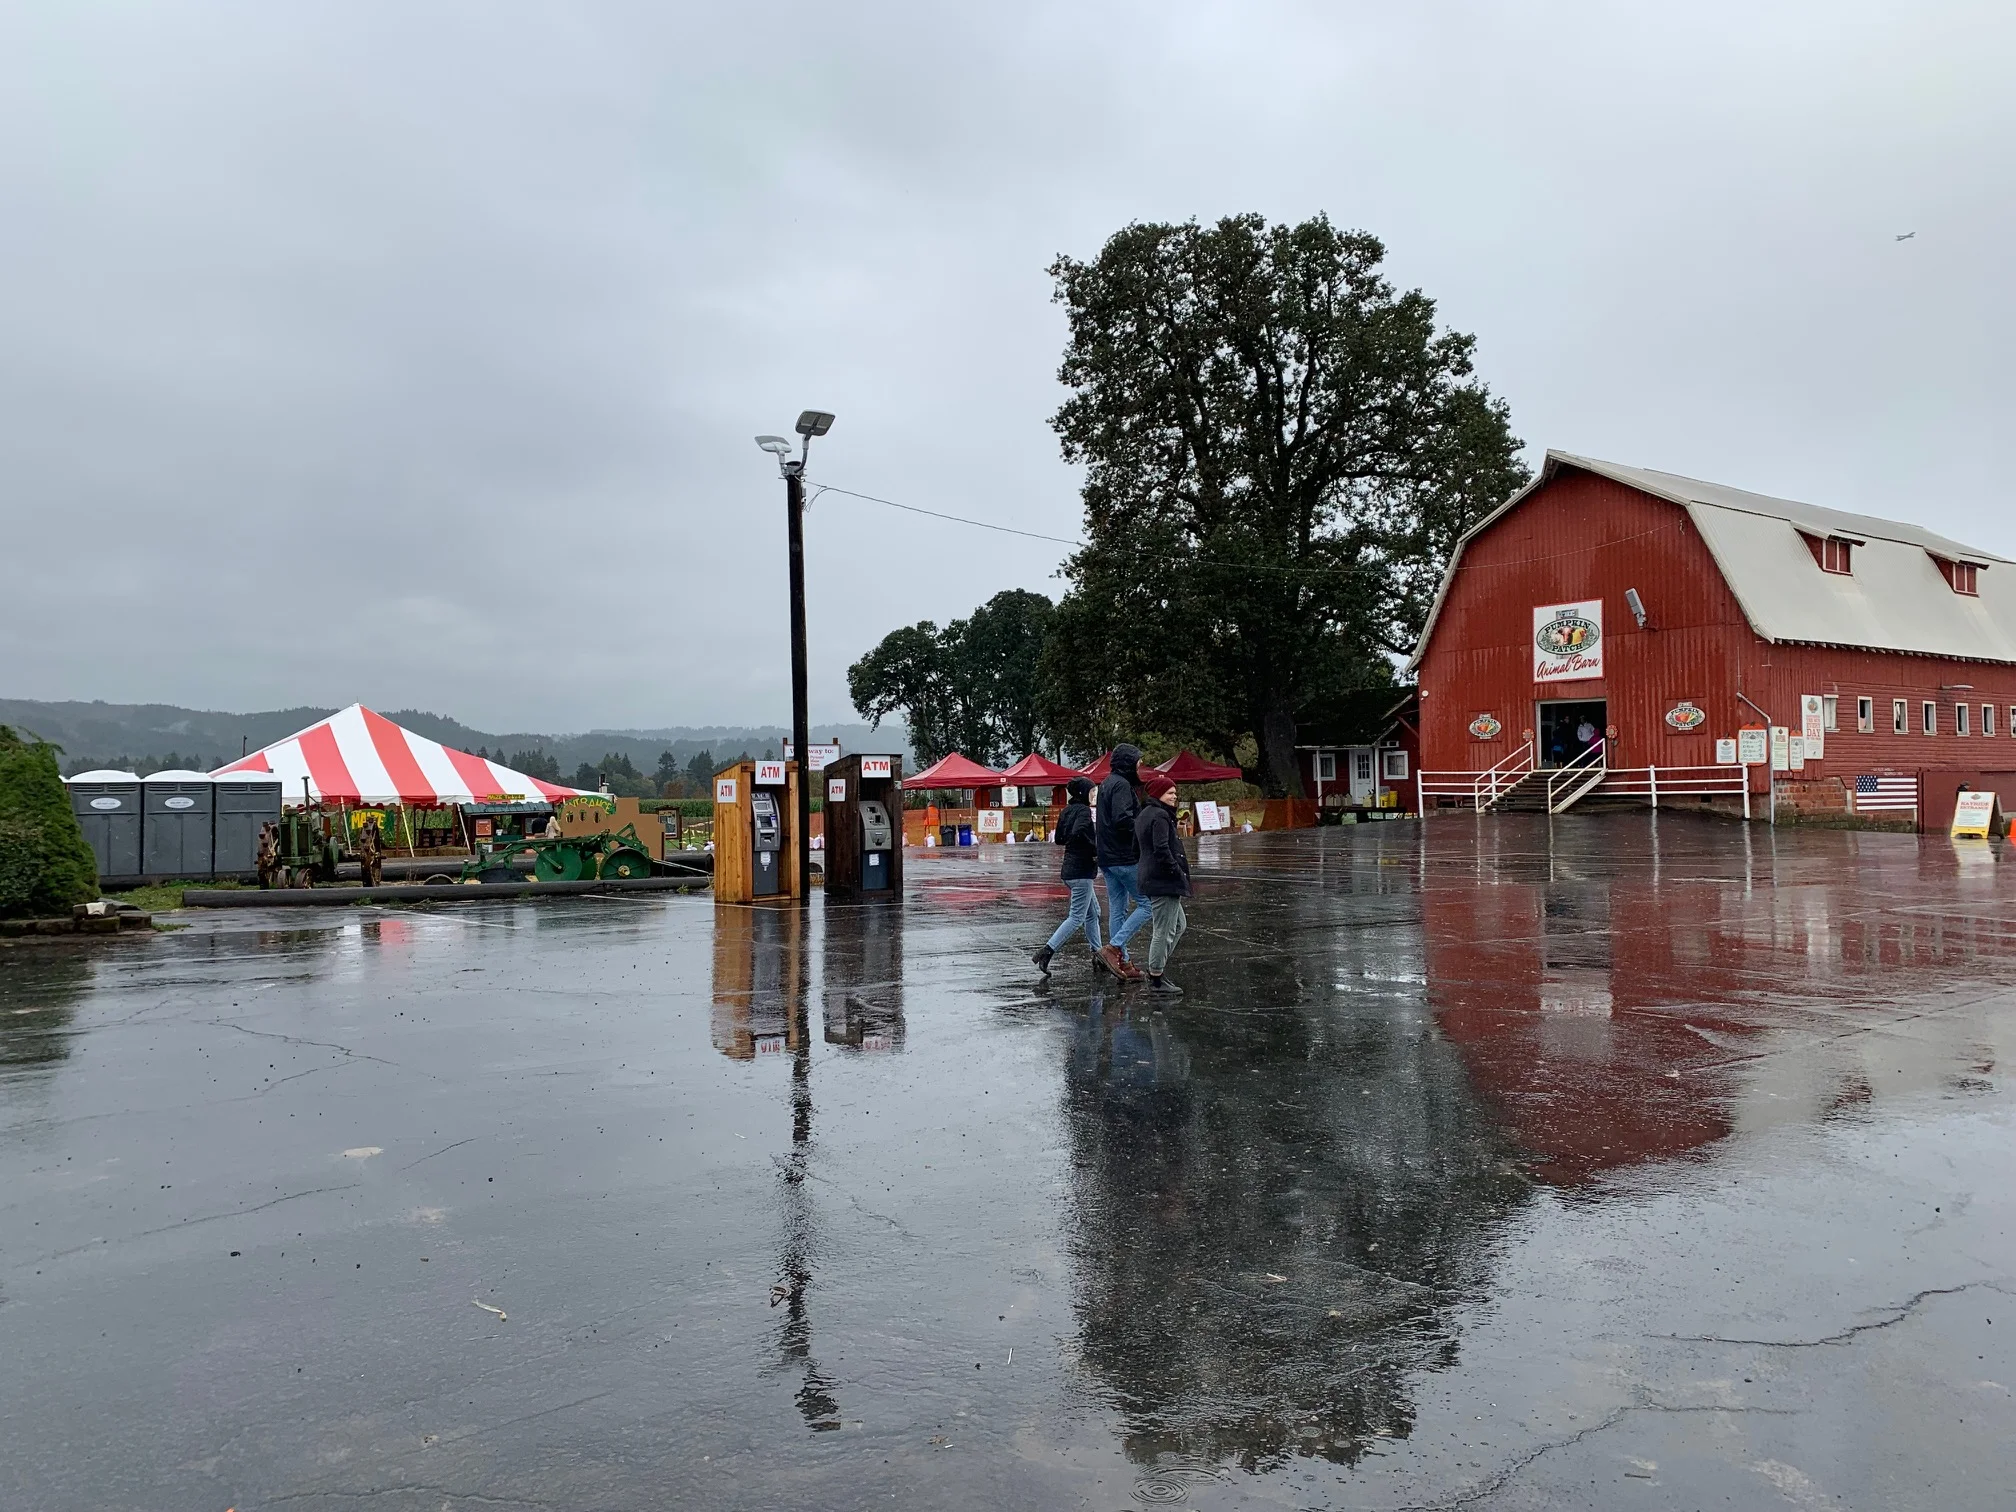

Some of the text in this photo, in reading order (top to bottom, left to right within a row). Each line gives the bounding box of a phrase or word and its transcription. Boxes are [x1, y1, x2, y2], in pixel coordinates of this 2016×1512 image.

[1544, 619, 1591, 635] PUMPKIN
[1552, 643, 1583, 653] PATCH
[1536, 654, 1600, 680] Animal Barn
[1807, 729, 1820, 737] DAY
[863, 761, 889, 771] ATM
[760, 766, 780, 778] ATM
[720, 785, 733, 797] ATM
[831, 785, 844, 795] ATM
